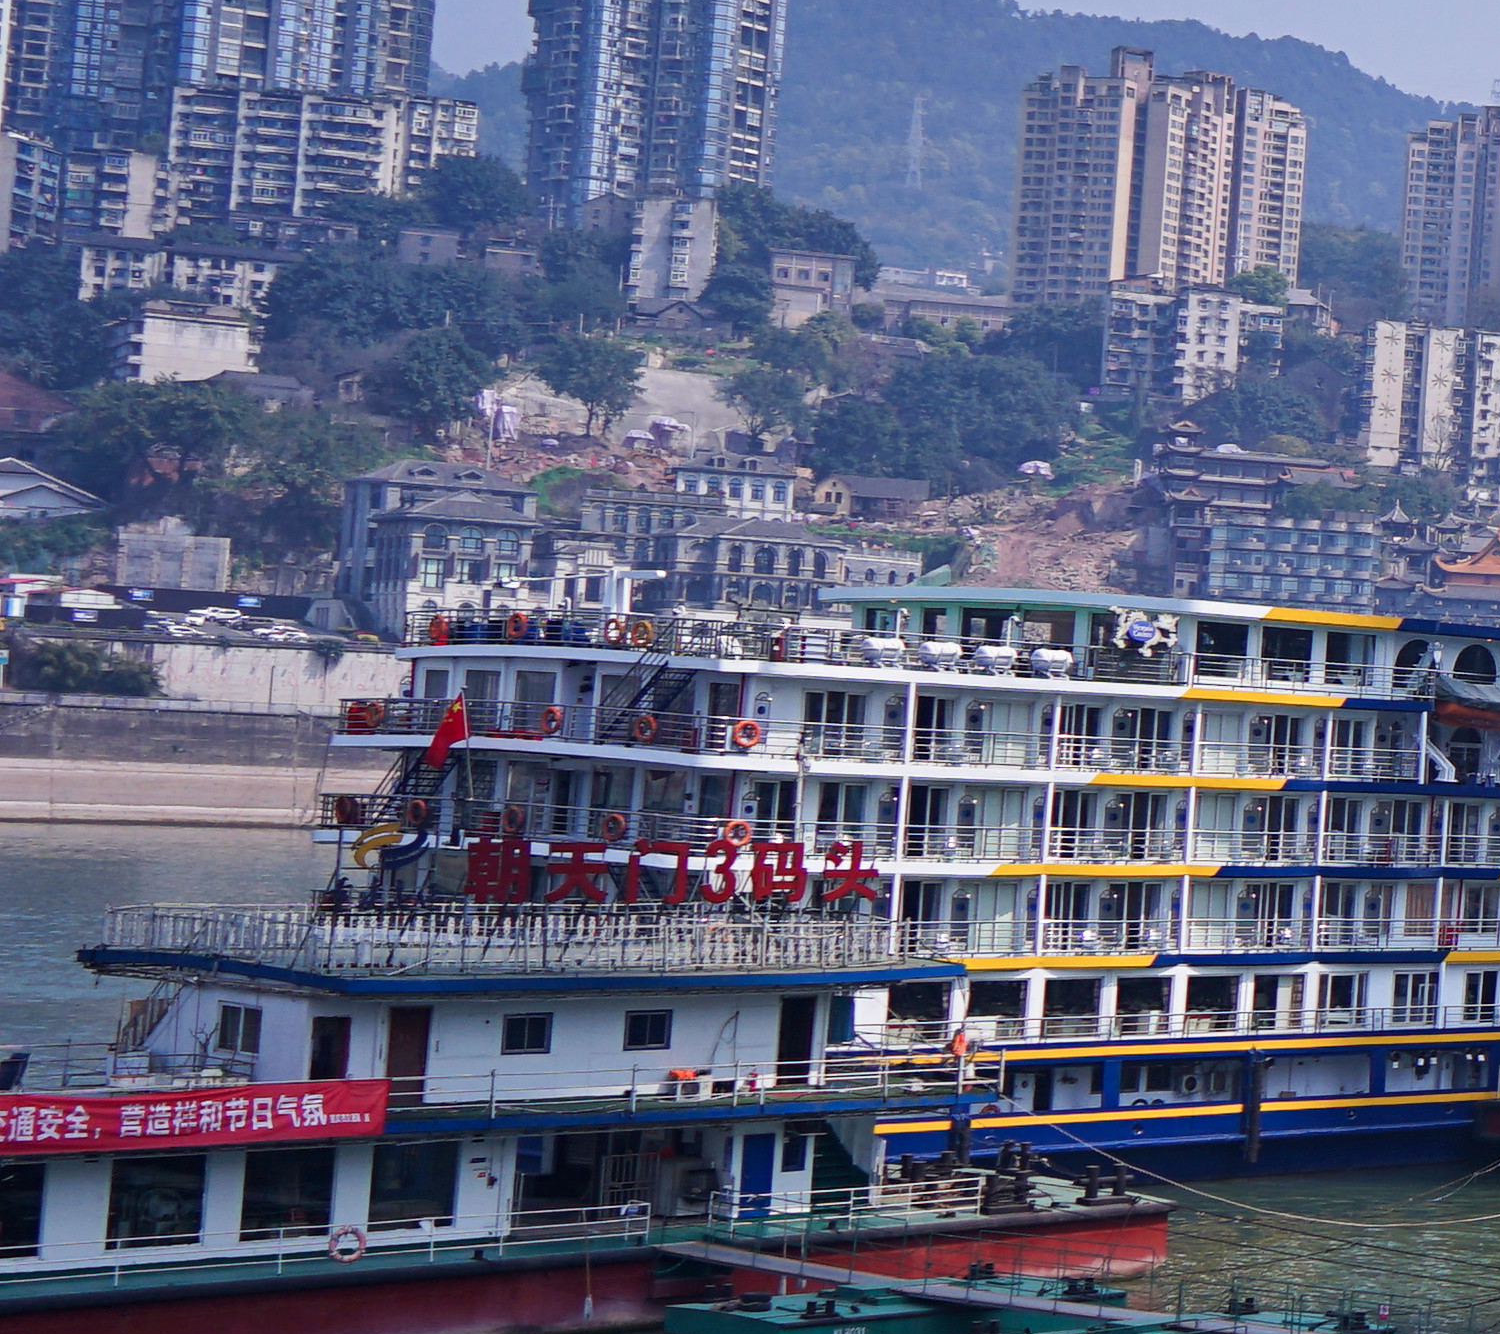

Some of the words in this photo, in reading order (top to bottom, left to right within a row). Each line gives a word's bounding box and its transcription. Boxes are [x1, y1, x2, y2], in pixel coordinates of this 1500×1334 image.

[464, 839, 879, 905] 朝天门3码头
